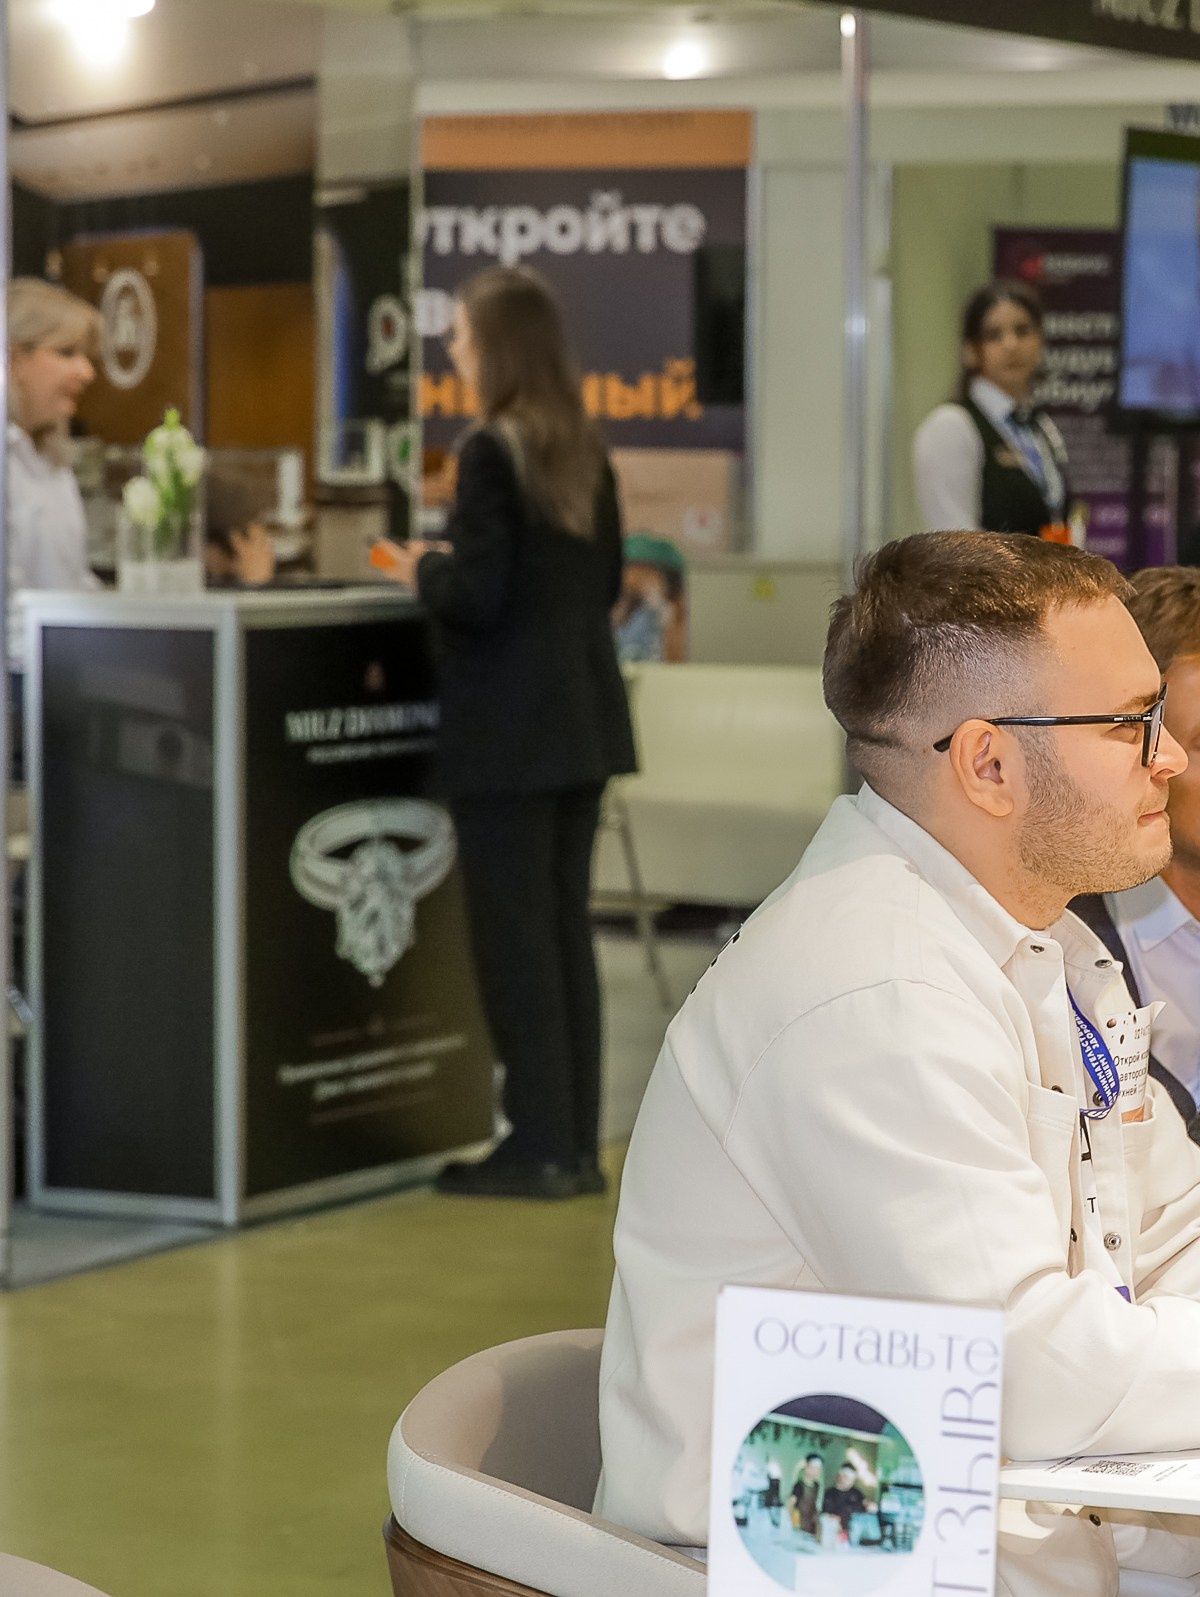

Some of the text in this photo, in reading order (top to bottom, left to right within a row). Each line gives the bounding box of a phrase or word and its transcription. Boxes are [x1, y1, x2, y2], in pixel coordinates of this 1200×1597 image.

[1097, 1053, 1116, 1089] ВАШЕМУ
[1113, 1051, 1140, 1067] Открой
[931, 1380, 999, 1597] тзыв
